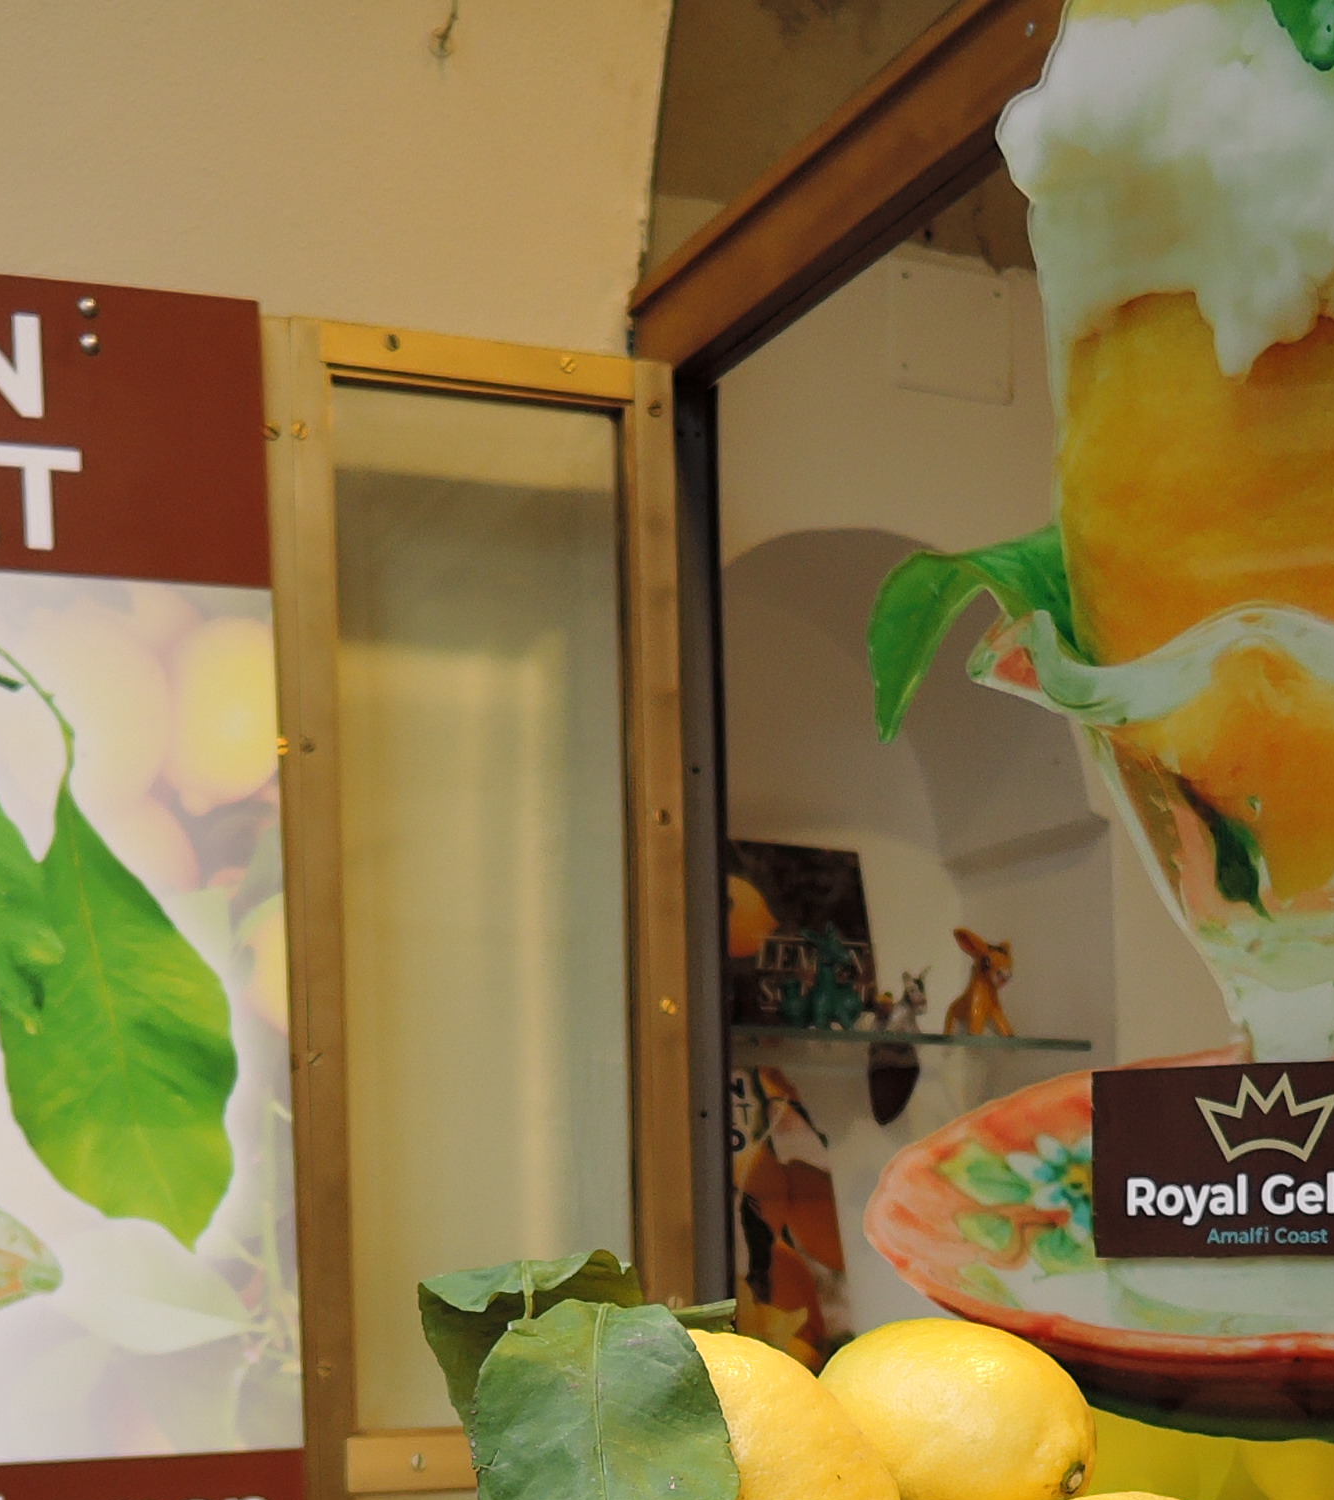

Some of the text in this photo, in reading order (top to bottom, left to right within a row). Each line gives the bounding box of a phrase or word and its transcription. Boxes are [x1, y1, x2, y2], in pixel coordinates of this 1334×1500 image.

[1125, 1173, 1249, 1226] Royal
[1207, 1226, 1328, 1244] Amalfi Coast
